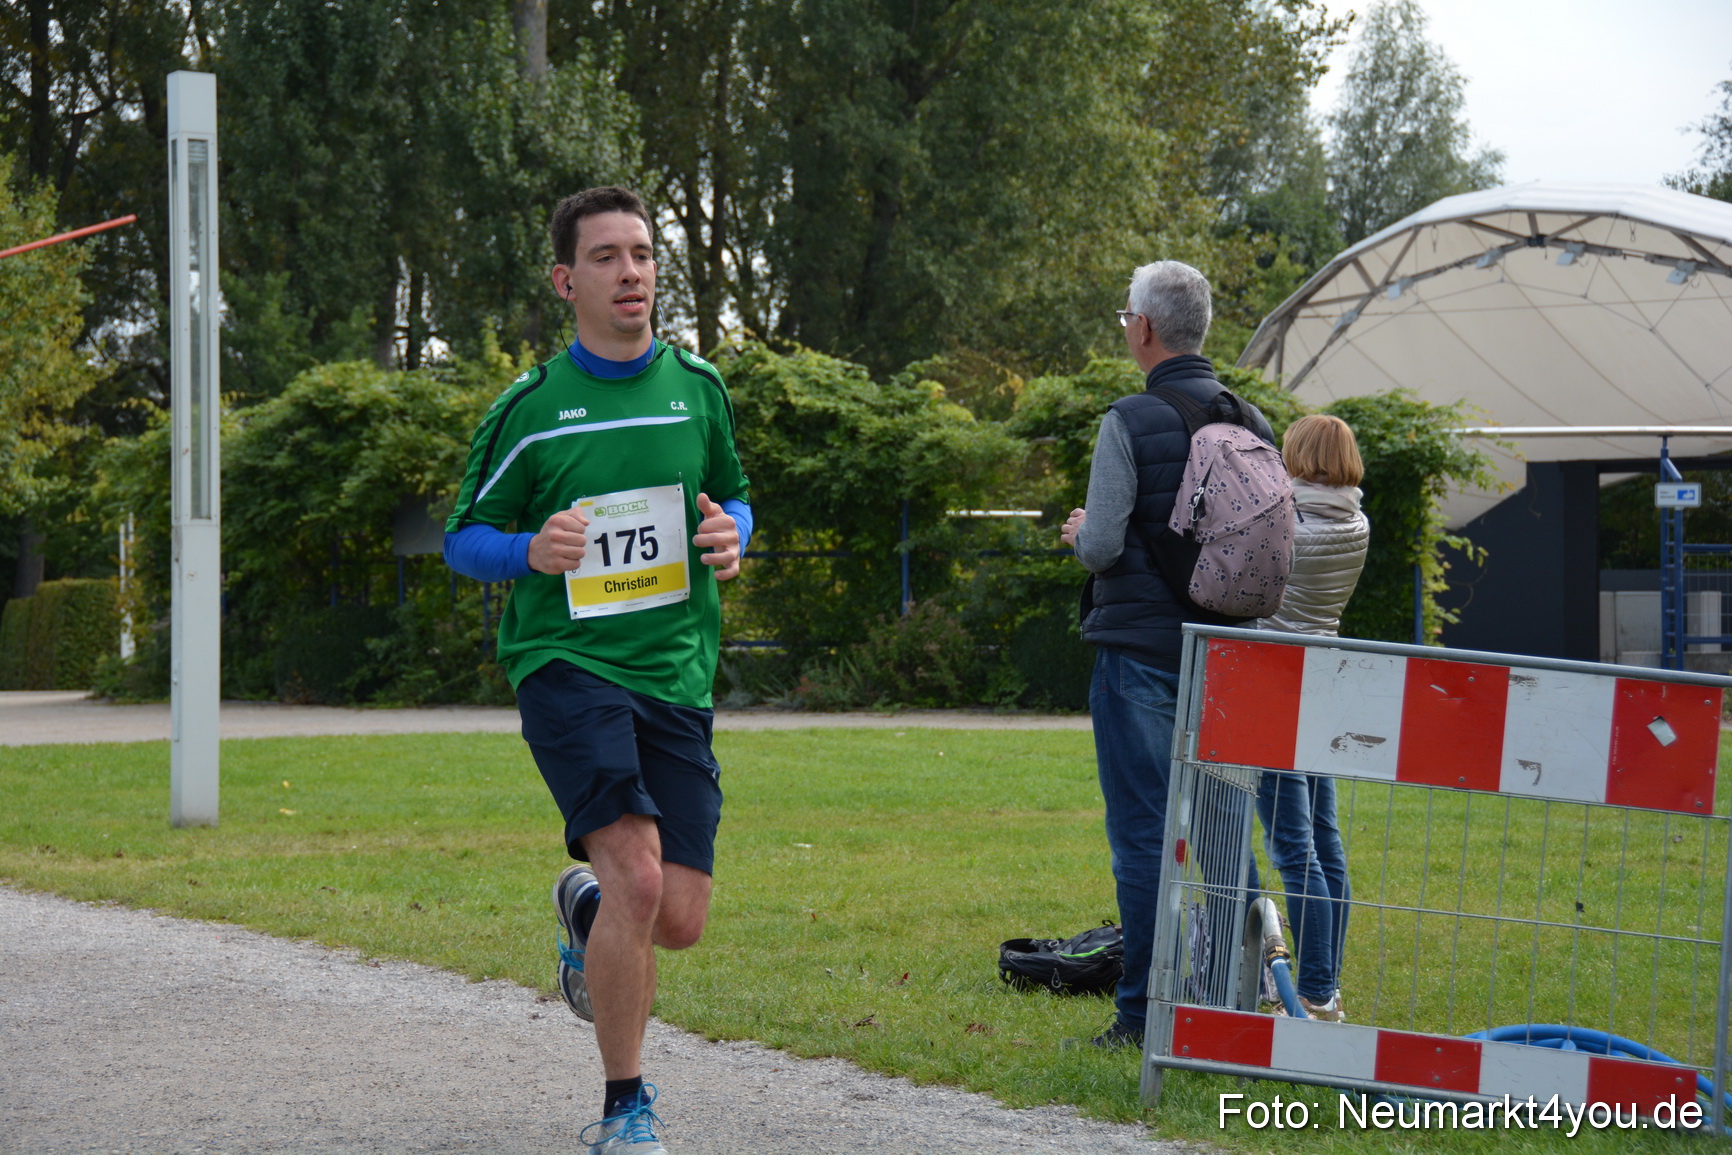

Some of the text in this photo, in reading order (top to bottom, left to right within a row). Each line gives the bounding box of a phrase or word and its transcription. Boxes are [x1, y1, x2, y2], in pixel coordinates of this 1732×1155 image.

[558, 407, 587, 421] JAKO
[670, 401, 688, 411] C.R.
[606, 499, 649, 516] BOCK
[593, 525, 659, 567] 175
[604, 575, 658, 594] Christian
